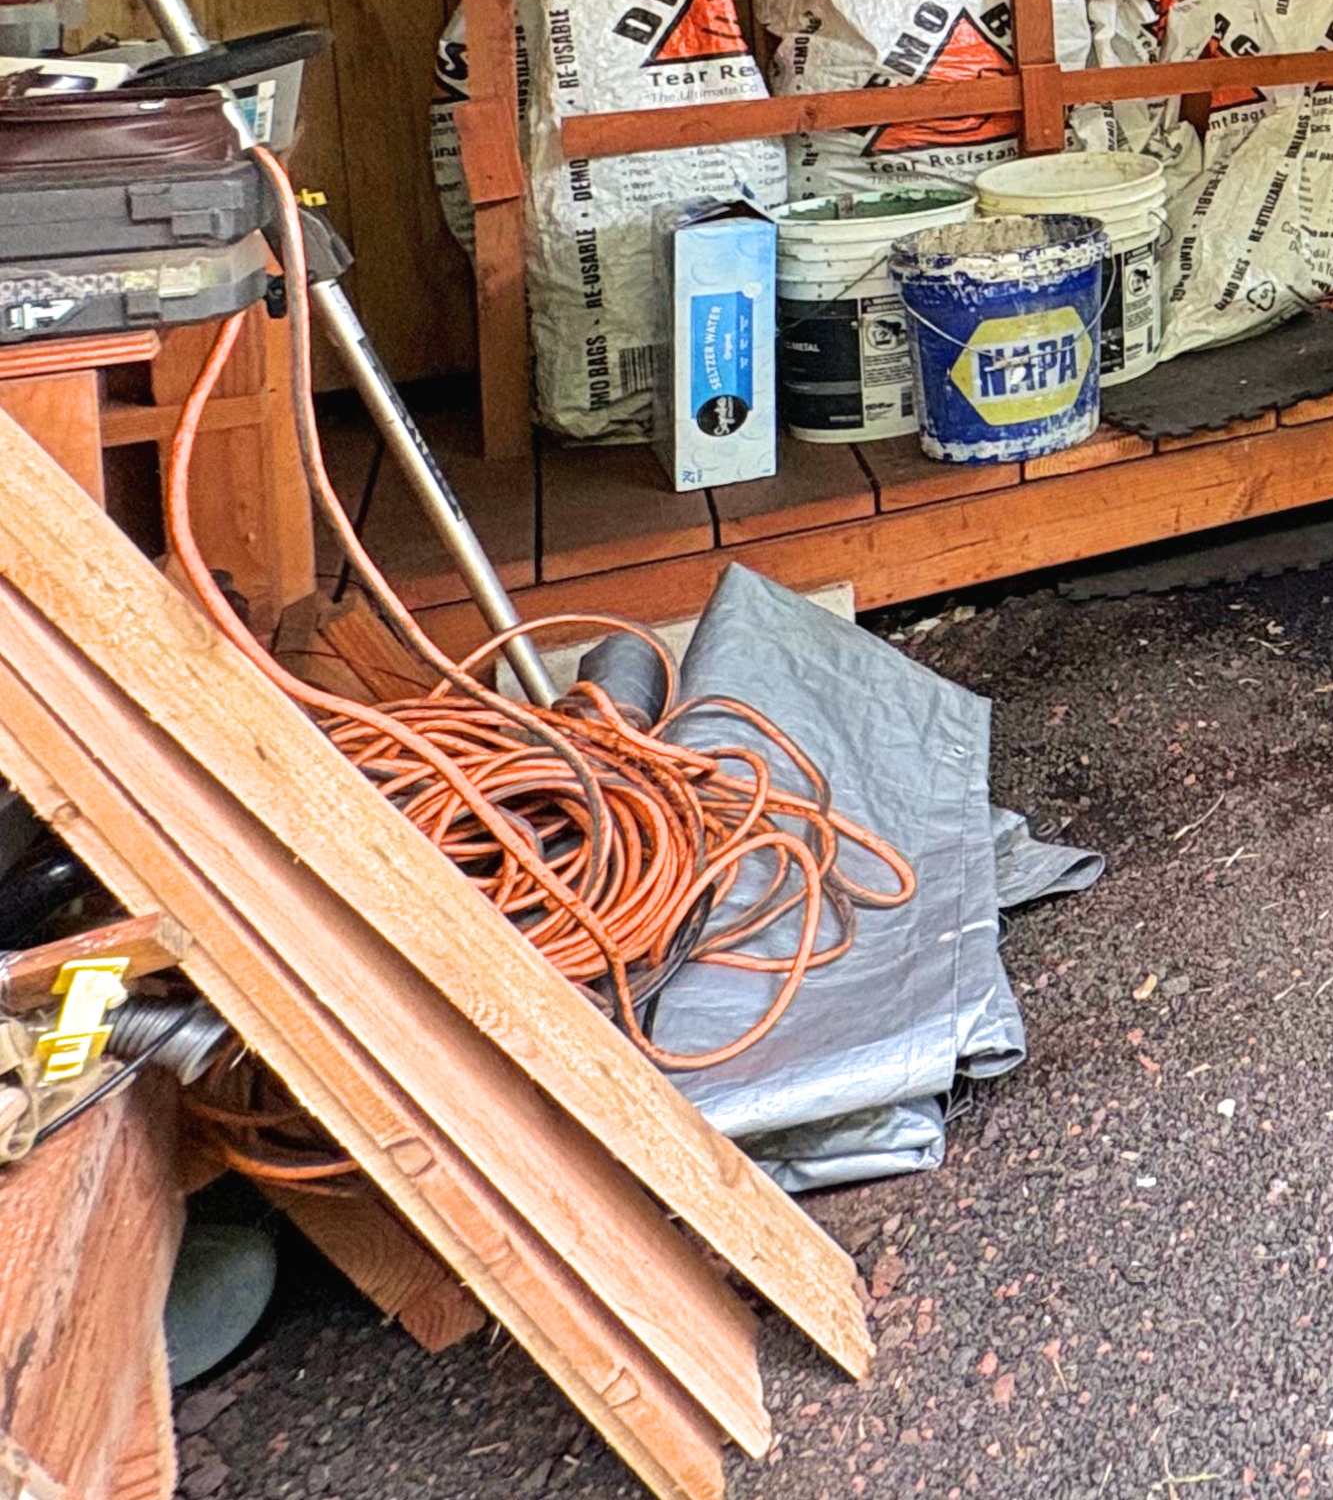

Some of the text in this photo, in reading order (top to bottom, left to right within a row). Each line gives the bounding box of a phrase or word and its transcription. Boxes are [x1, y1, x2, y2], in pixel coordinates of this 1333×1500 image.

[548, 7, 580, 90] RE-USABLE
[650, 69, 708, 88] Tear
[568, 158, 594, 203] DEMO
[866, 158, 920, 175] Tear
[1248, 170, 1289, 244] RE-UTILIZABLE
[575, 227, 604, 311] RE-USABLE
[1179, 236, 1196, 272] DEMO
[1214, 278, 1241, 312] DEMO
[586, 333, 610, 376] BAGS
[704, 305, 723, 392] SELTZER WATER
[977, 332, 1079, 399] NAPA
